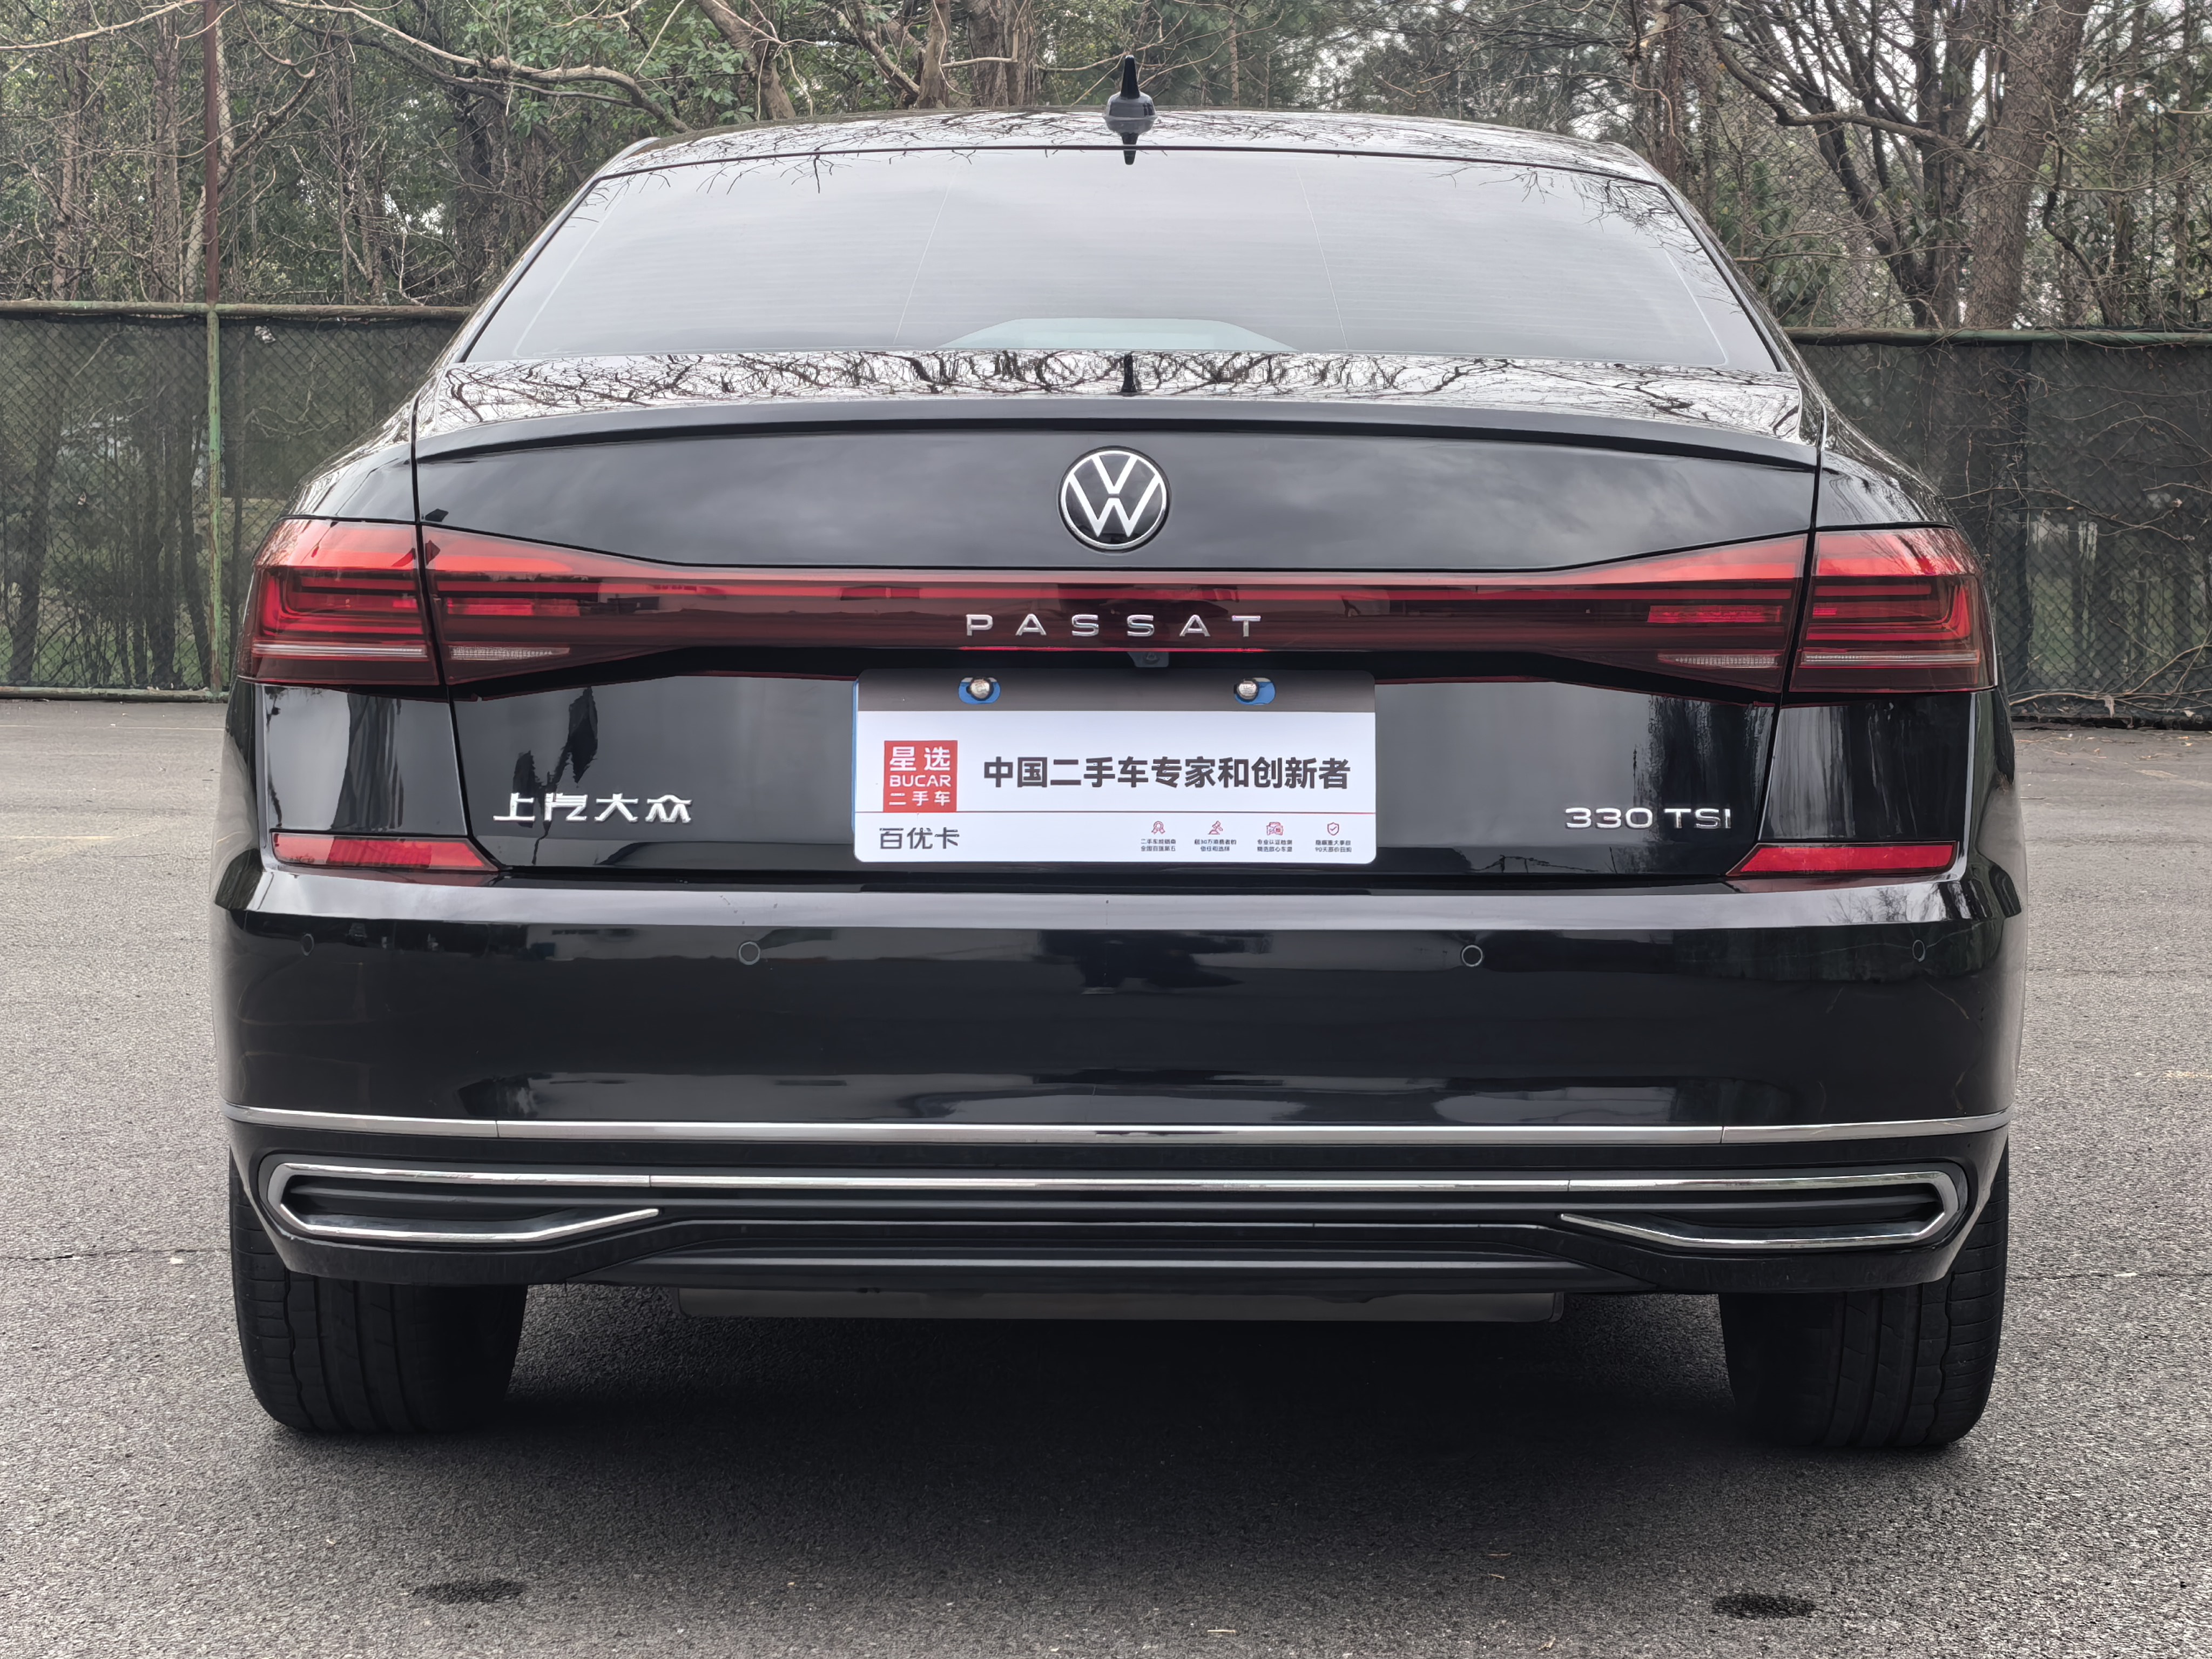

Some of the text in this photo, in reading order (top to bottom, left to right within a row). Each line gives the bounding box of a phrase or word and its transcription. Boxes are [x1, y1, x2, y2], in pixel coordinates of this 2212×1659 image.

[966, 613, 1261, 637] PASSAT
[889, 746, 950, 771] 星选
[889, 774, 951, 787] BUCAR
[983, 756, 1351, 790] 中国二手车专家和创新者
[493, 792, 692, 823] 上汽大众
[889, 791, 950, 806] 二手车
[1565, 807, 1731, 829] 330 TSI
[879, 826, 960, 849] 百优卡
